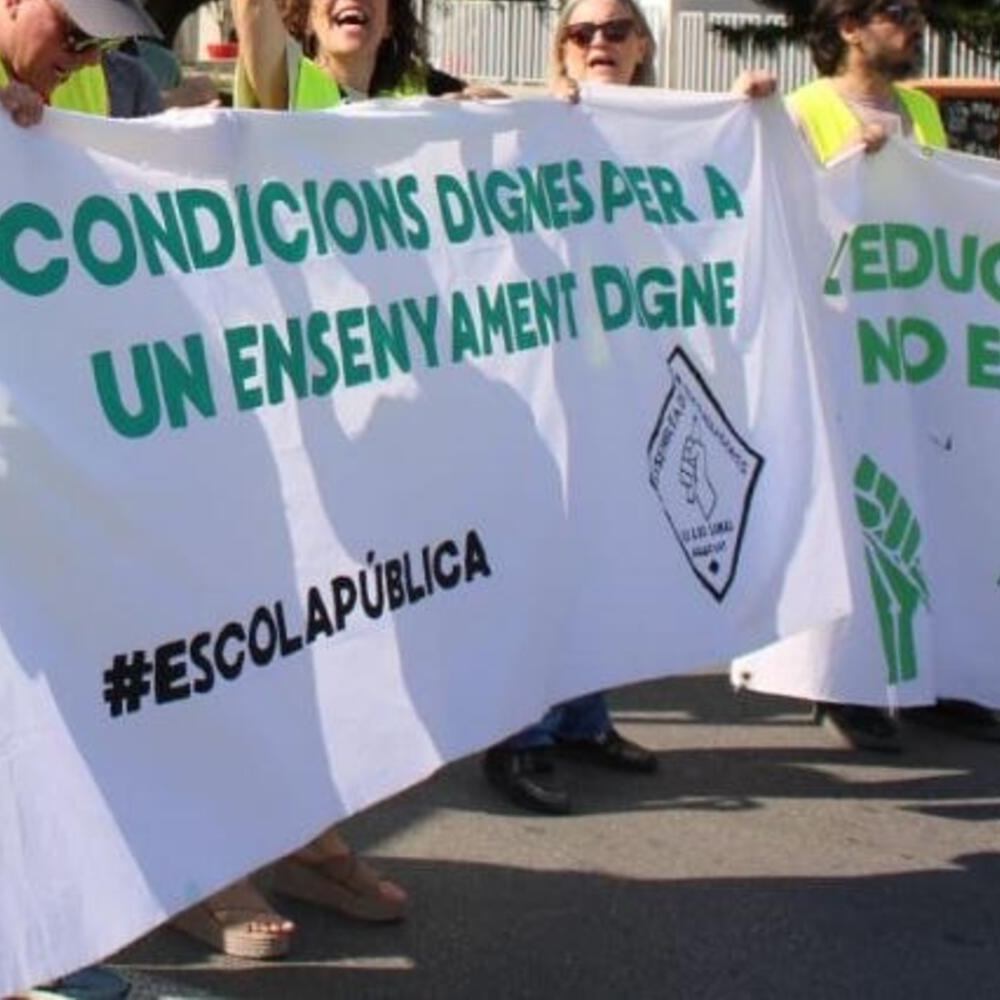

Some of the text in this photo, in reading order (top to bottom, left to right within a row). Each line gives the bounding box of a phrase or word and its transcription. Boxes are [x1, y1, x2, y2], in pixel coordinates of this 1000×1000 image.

[436, 159, 595, 244] DIGNES
[600, 160, 698, 224] PER
[703, 165, 743, 219] A
[90, 333, 217, 438] UN
[223, 271, 579, 413] ENSENYAMENT
[857, 316, 947, 385] NO
[103, 529, 492, 718] #ESCOLAPÚBLICA
